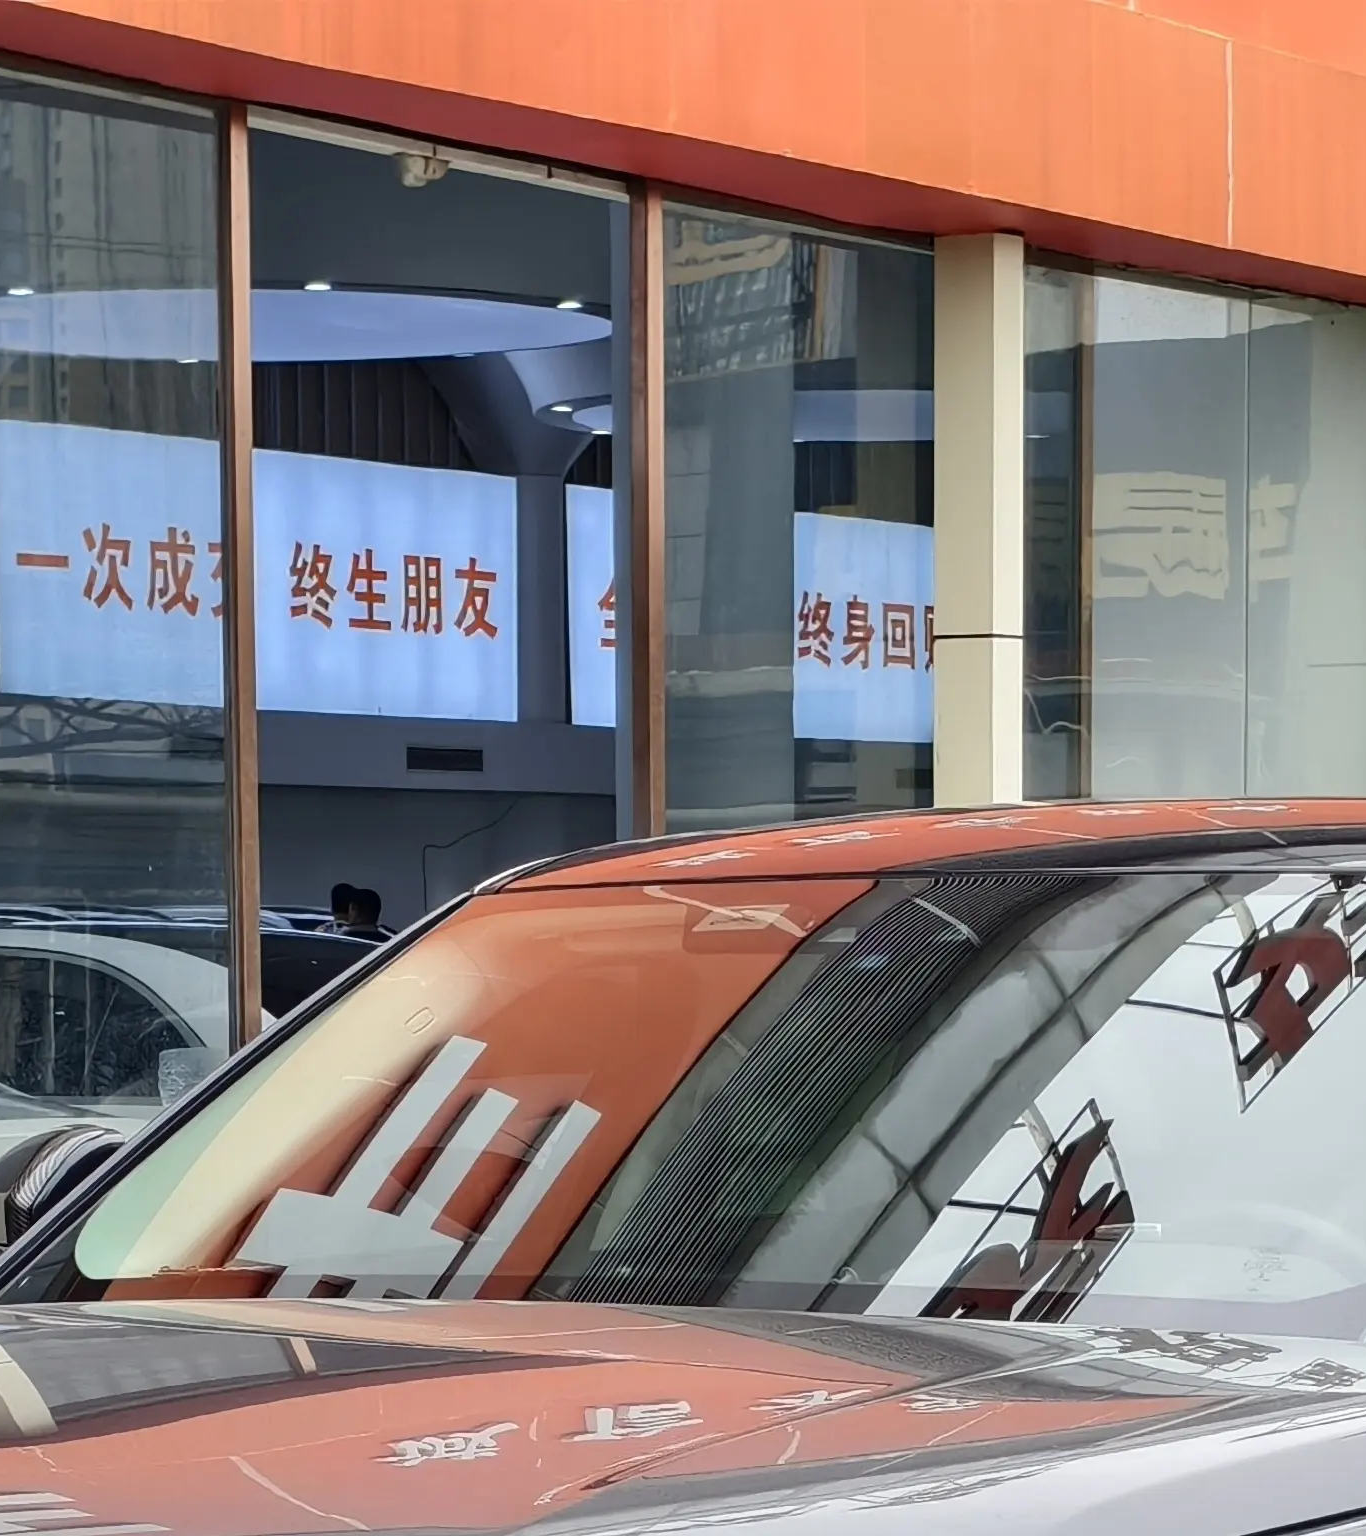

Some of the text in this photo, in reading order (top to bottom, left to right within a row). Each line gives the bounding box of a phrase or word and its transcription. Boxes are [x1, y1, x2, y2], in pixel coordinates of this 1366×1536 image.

[16, 522, 223, 618] 一次成
[289, 540, 498, 640] 终生朋友
[797, 589, 934, 673] 终身回
